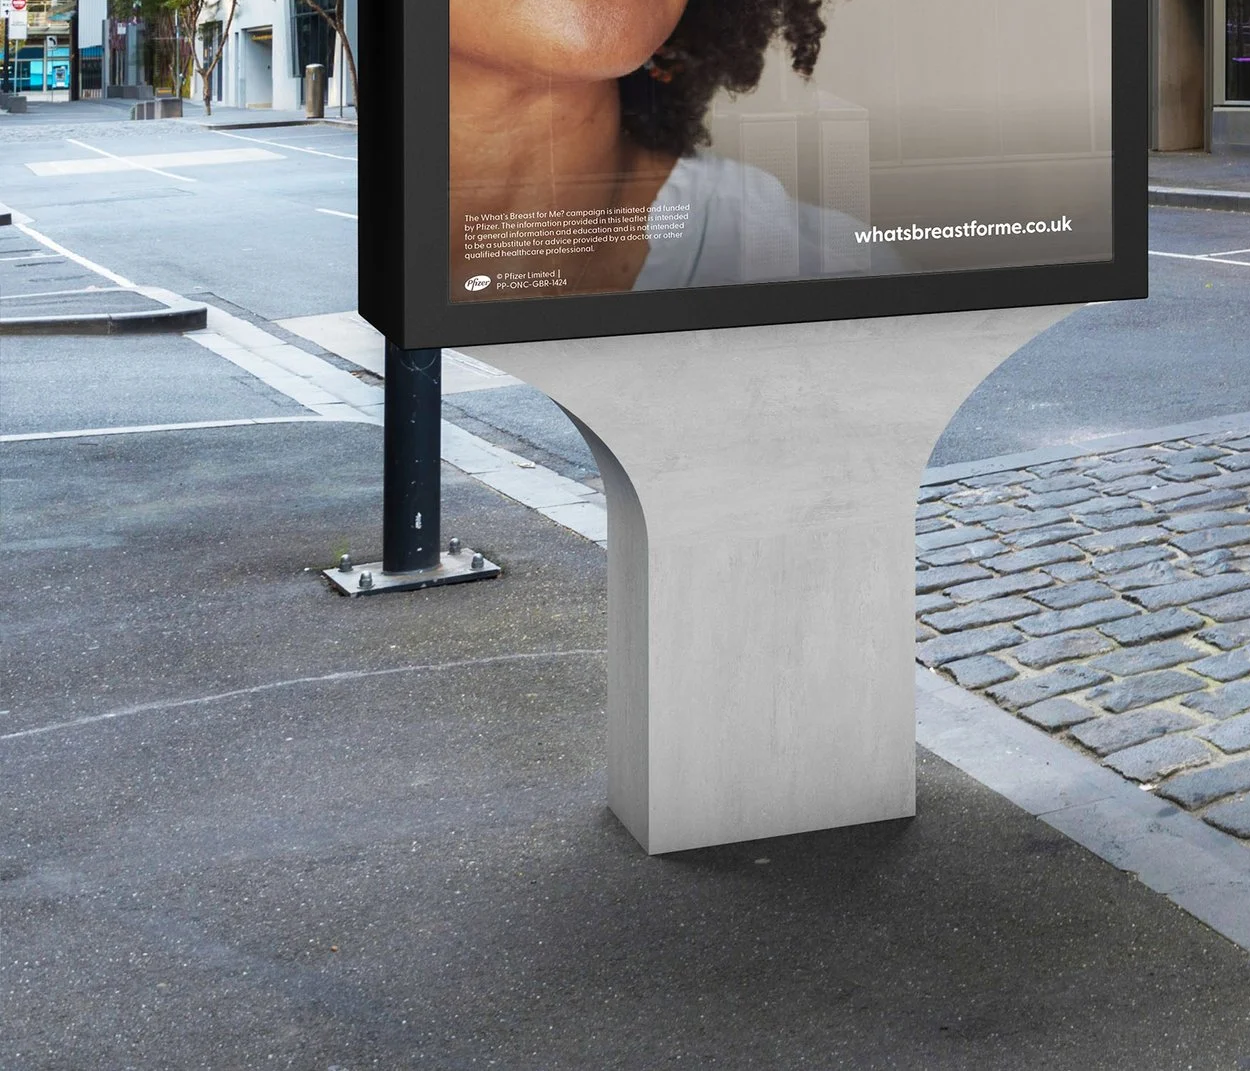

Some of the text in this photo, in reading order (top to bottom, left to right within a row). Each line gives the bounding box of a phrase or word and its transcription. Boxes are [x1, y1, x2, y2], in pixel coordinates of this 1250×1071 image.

[465, 214, 479, 222] The
[481, 213, 509, 221] What’s
[510, 212, 535, 220] Breast
[536, 211, 547, 219] for
[549, 210, 564, 218] Me?
[566, 208, 605, 217] campaign
[613, 206, 645, 215] initiated
[646, 205, 662, 213] and
[662, 204, 690, 212] funded
[465, 224, 474, 232] by
[476, 223, 500, 231] Pfizer.
[501, 222, 515, 230] The
[516, 220, 562, 229] information
[563, 217, 598, 227] provided
[607, 215, 621, 224] this
[622, 214, 647, 223] leaflet
[648, 214, 654, 222] is
[654, 212, 689, 221] intended
[465, 233, 475, 241] for
[477, 231, 508, 241] general
[509, 229, 554, 238] information
[555, 227, 571, 235] and
[572, 226, 612, 234] education
[613, 224, 629, 233] and
[629, 224, 635, 232] is
[650, 222, 685, 231] intended
[855, 215, 1073, 243] whatsbreastforme.co.uk
[474, 242, 485, 250] be
[493, 239, 531, 248] substitute
[532, 238, 544, 246] for
[545, 237, 572, 245] advice
[573, 234, 608, 245] provided
[609, 234, 619, 243] by
[627, 233, 652, 241] doctor
[663, 231, 683, 239] other
[465, 245, 594, 260] qualified healthcare professional.
[466, 277, 490, 291] Pfizer
[504, 272, 526, 280] Pfizer
[527, 270, 555, 279] Limited
[496, 279, 567, 290] PP-ONC-GBR-1424
